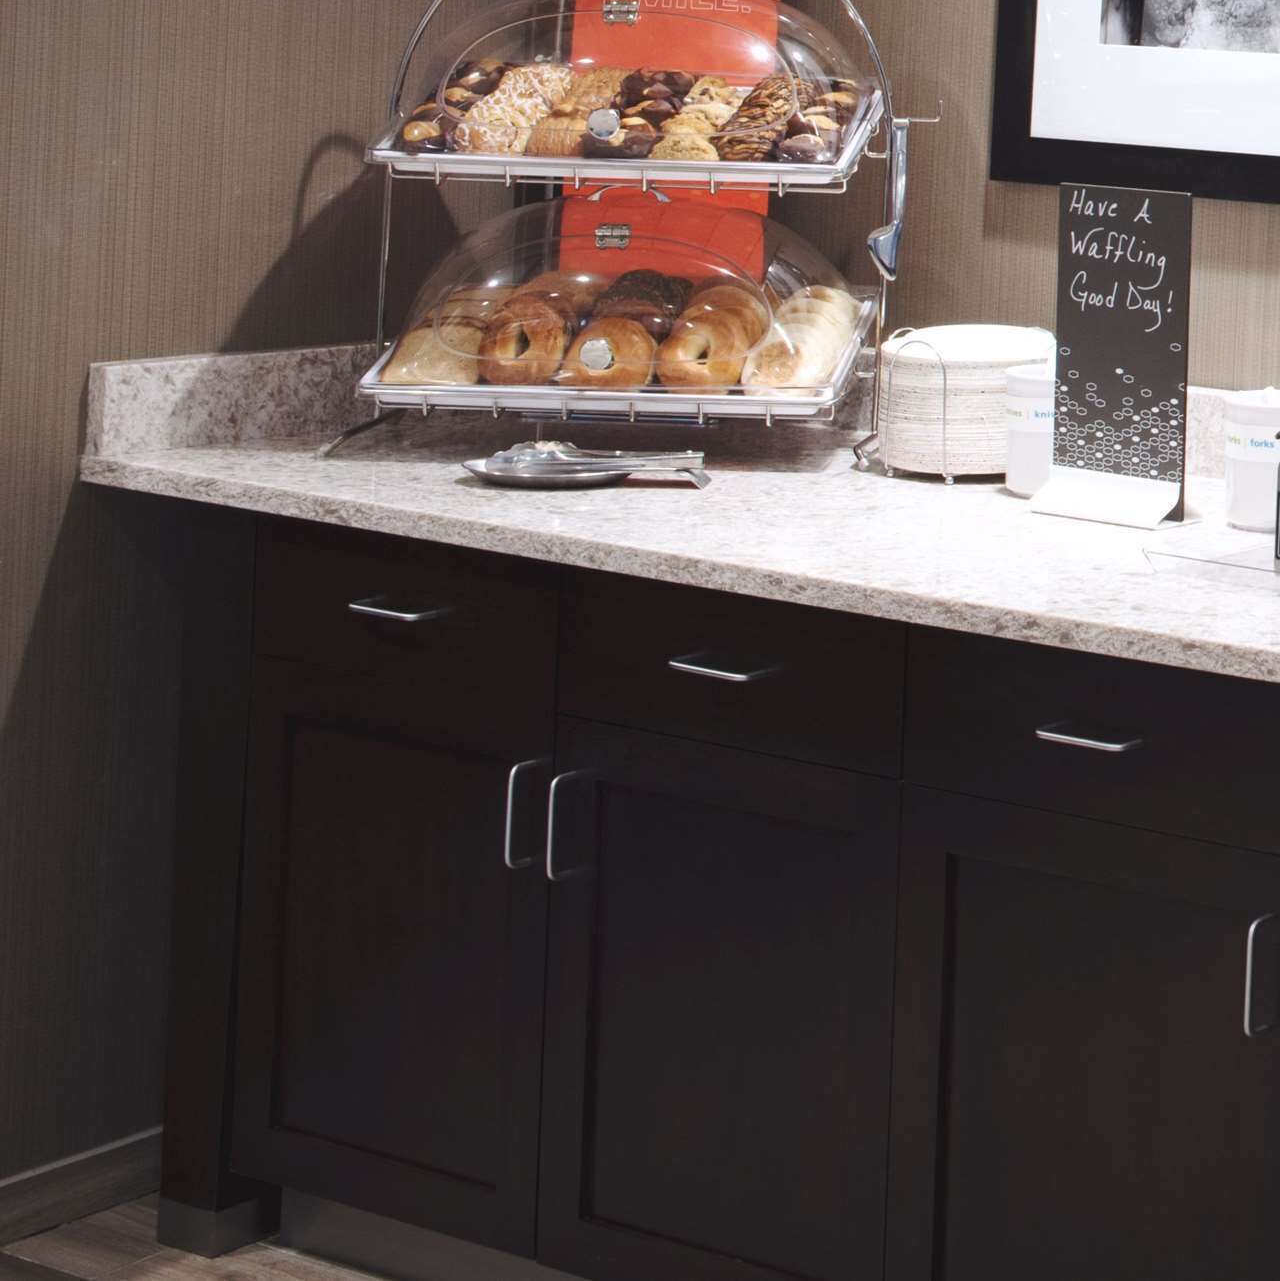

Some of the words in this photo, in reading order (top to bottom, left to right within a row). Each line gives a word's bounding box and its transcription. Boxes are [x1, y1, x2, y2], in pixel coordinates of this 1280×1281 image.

[1069, 188, 1118, 217] Have
[1133, 198, 1152, 223] A
[1071, 227, 1167, 290] Waffling
[1070, 270, 1118, 312] Good
[1126, 280, 1173, 332] Day!
[1249, 438, 1274, 448] forks
